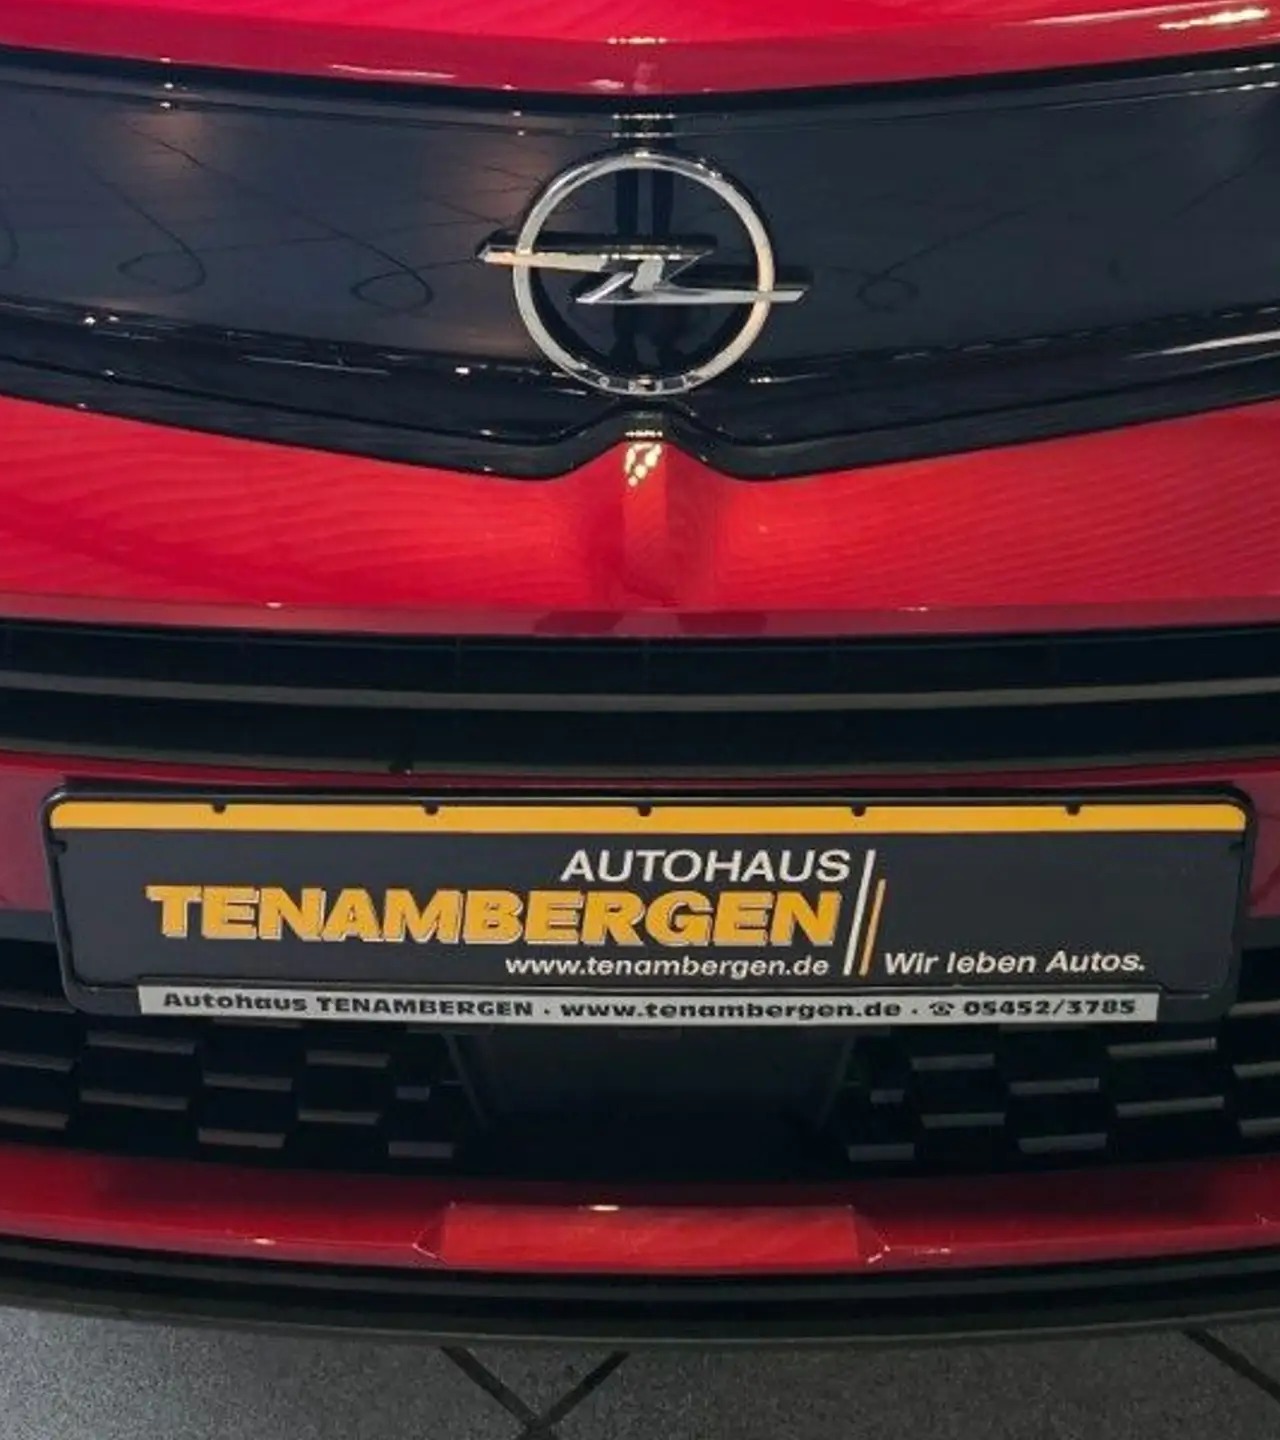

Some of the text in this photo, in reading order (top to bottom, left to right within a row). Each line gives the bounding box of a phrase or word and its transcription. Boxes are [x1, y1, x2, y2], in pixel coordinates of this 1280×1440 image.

[560, 849, 852, 882] AUTOHAUS
[145, 885, 843, 947] TENAMBERGEN
[505, 954, 830, 980] www.tenambergen.de
[884, 949, 1146, 974] Wir leben Autos.
[163, 992, 1137, 1021] Autohaus TENAMBERGEN www.tenambergen.de 05452/3785
